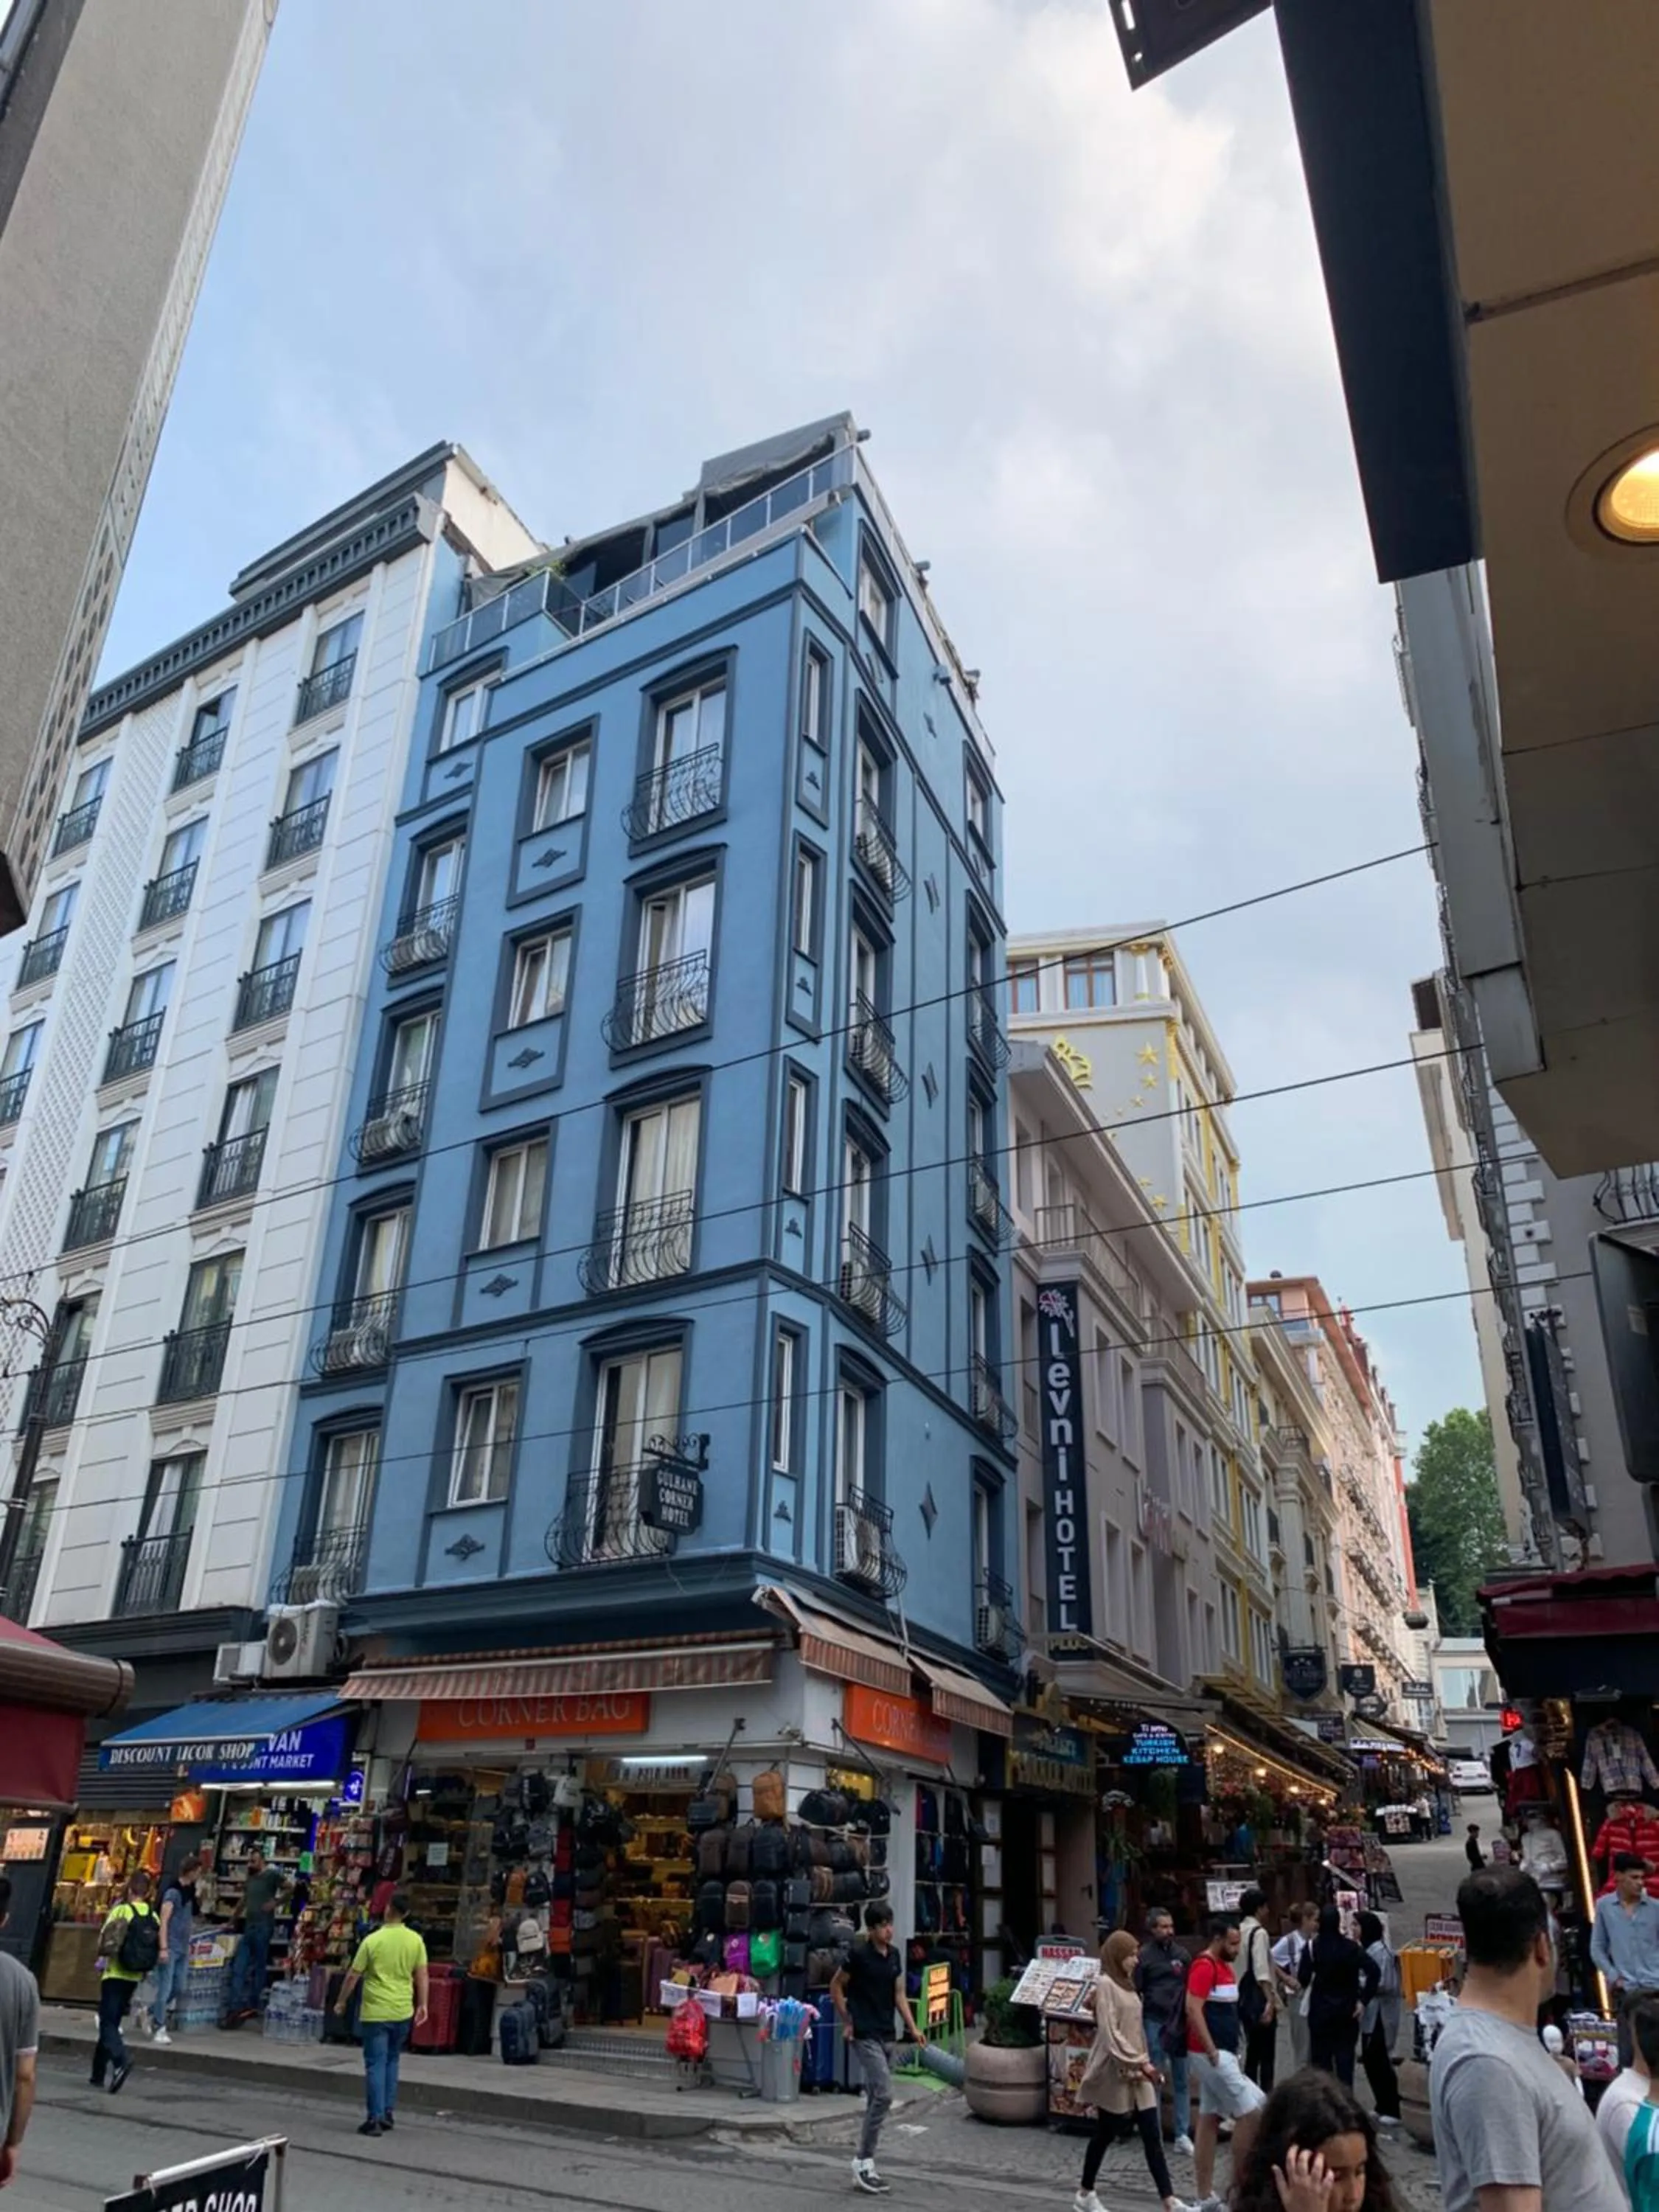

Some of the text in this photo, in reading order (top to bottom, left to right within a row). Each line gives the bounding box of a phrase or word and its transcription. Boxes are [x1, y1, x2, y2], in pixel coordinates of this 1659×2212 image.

[659, 1487, 694, 1512] CORNER
[661, 1504, 690, 1527] HOTEL
[1054, 1489, 1077, 1630] HOTEL
[458, 1693, 630, 1727] CORNER BAG
[872, 1698, 922, 1742] CORNE
[110, 1745, 173, 1764] DISCOUNT
[219, 1742, 255, 1759] SHOP
[268, 1754, 314, 1769] MARKET
[1155, 1756, 1189, 1764] HOUSE
